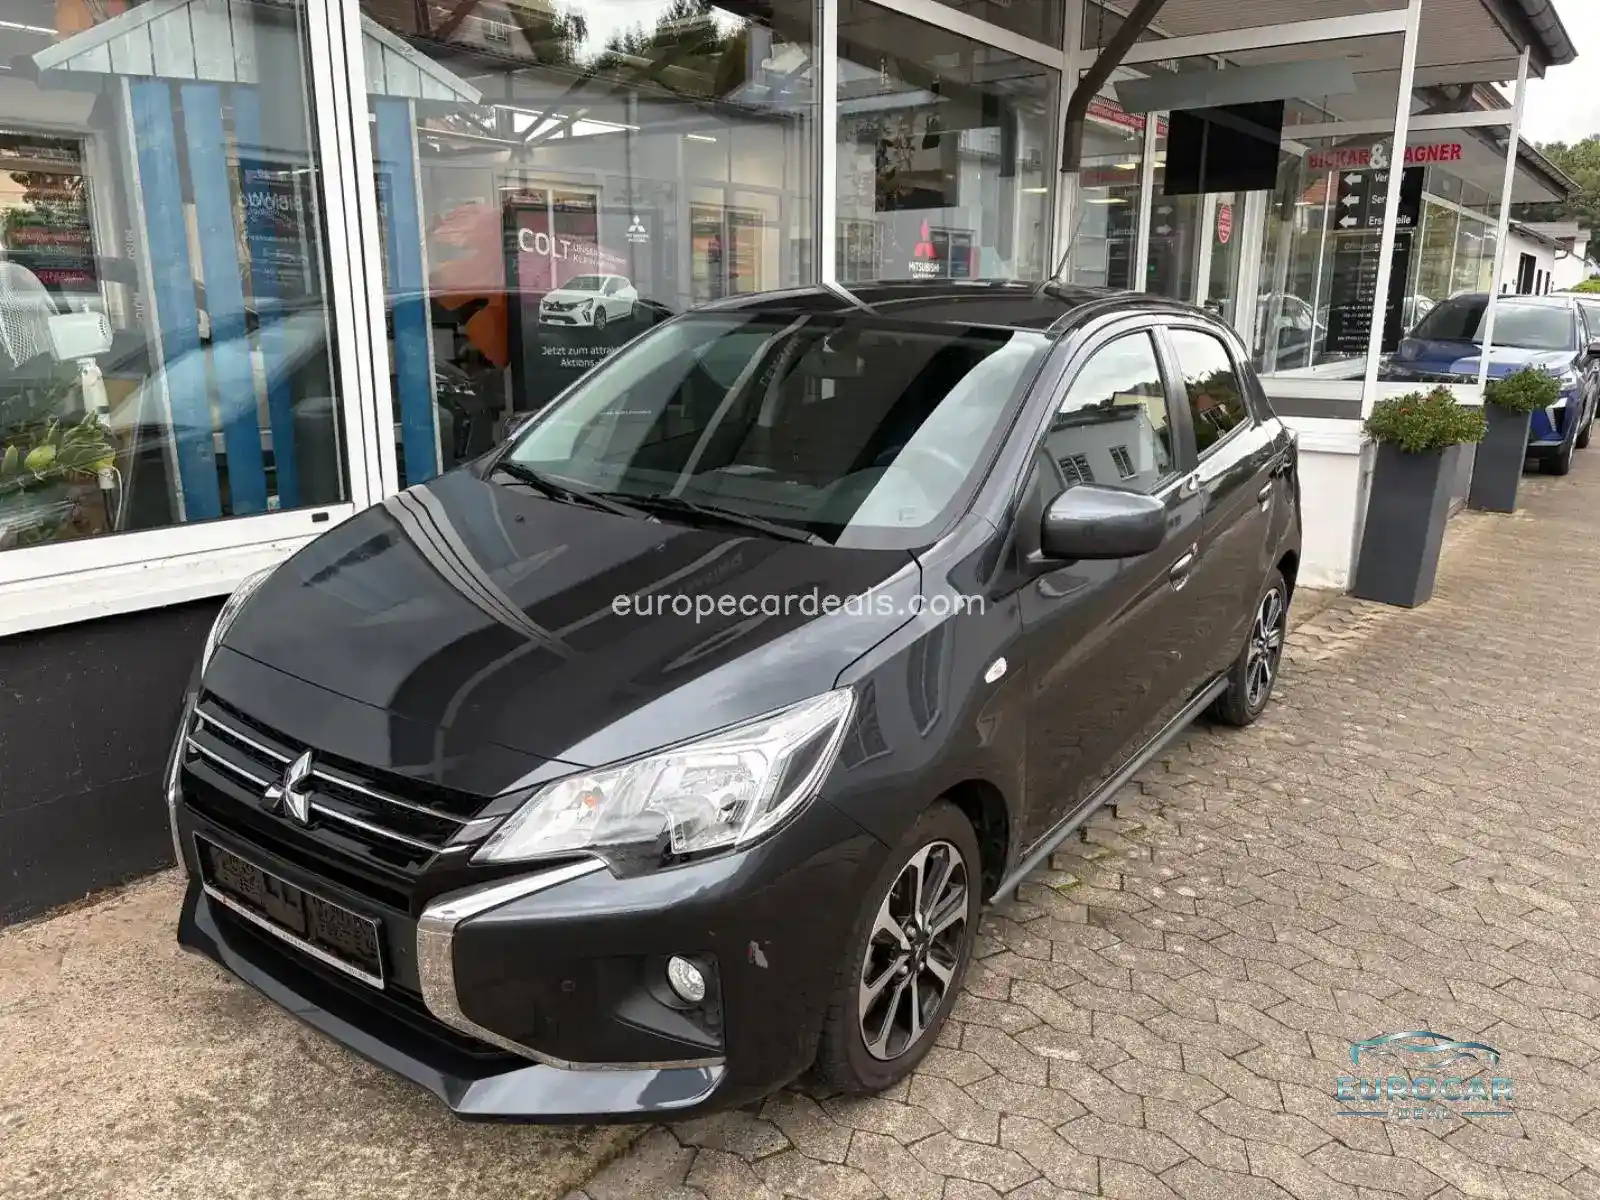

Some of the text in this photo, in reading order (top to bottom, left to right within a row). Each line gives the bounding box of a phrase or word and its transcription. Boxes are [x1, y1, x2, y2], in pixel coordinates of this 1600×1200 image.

[1403, 143, 1462, 163] AGNER
[518, 227, 572, 260] COLT
[541, 345, 567, 356] Jetzt
[568, 347, 588, 356] zum
